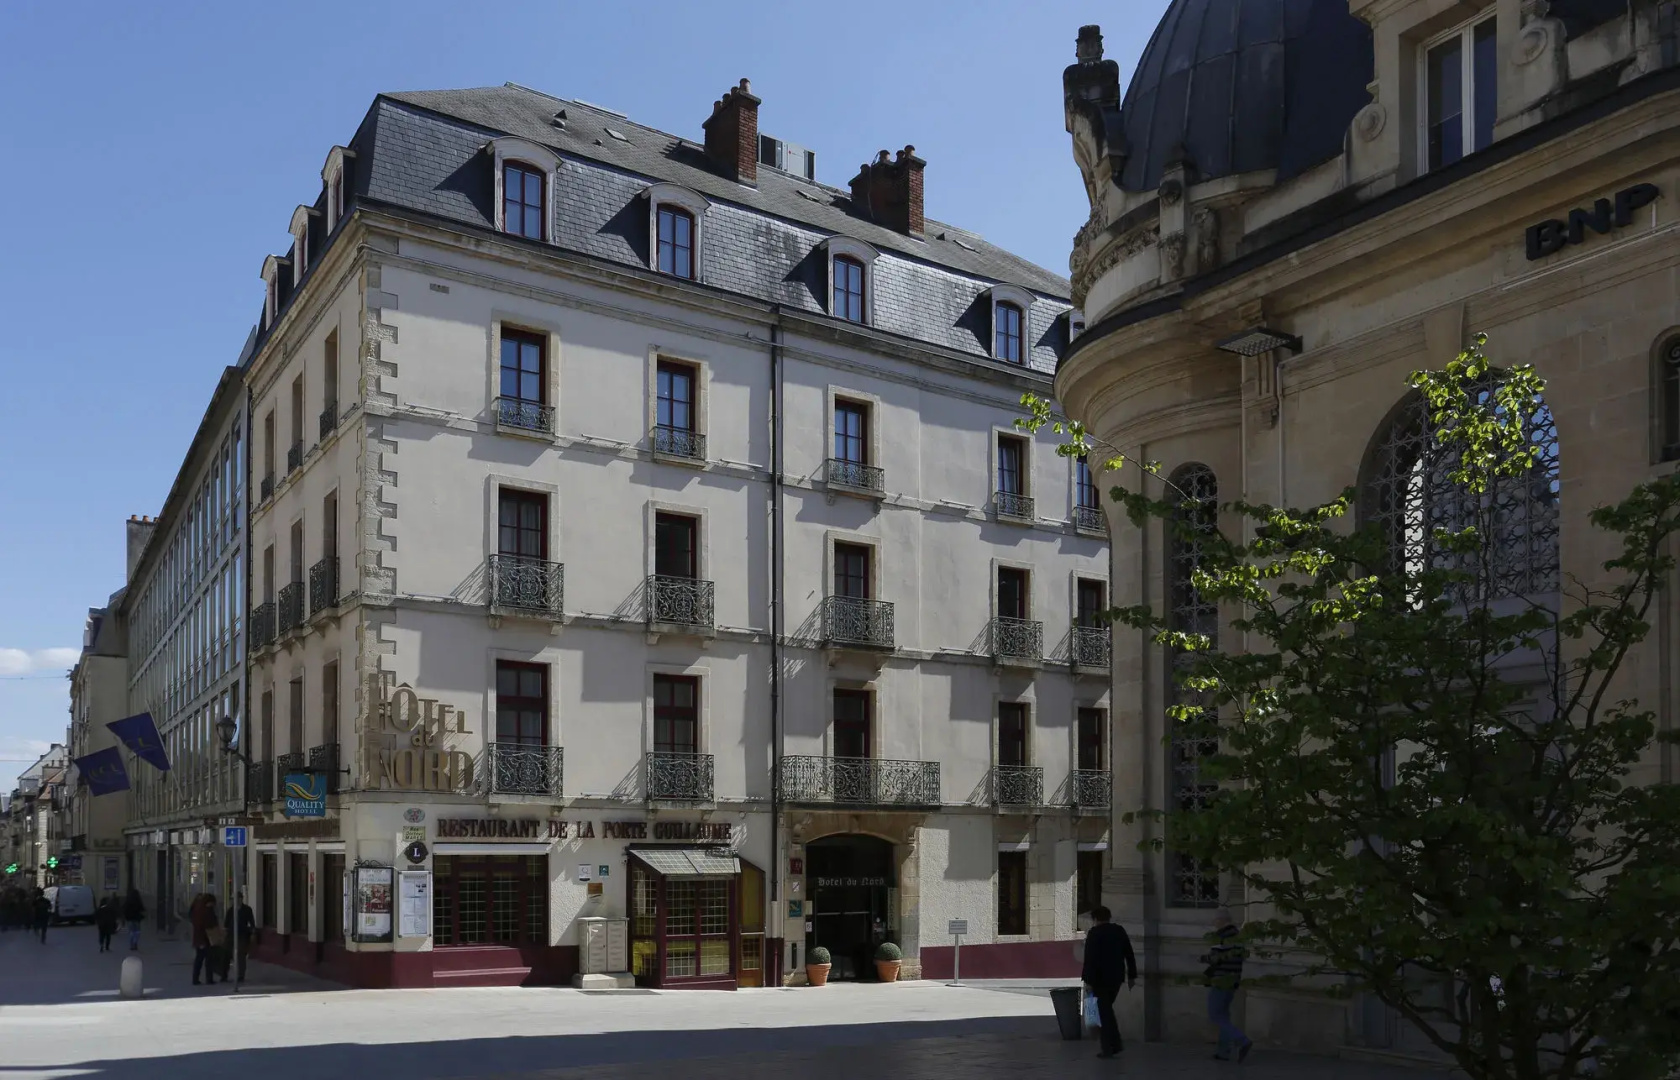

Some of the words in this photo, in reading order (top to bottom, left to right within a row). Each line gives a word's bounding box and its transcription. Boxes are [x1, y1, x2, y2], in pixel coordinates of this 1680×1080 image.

[1526, 183, 1660, 261] BNP
[368, 745, 475, 790] NORD
[287, 800, 325, 809] QUALITY
[437, 819, 540, 838] RESTAURANT
[547, 820, 568, 839] DE
[576, 820, 595, 838] LA
[602, 821, 647, 839] PORTE
[653, 821, 731, 840] GUILLAUME
